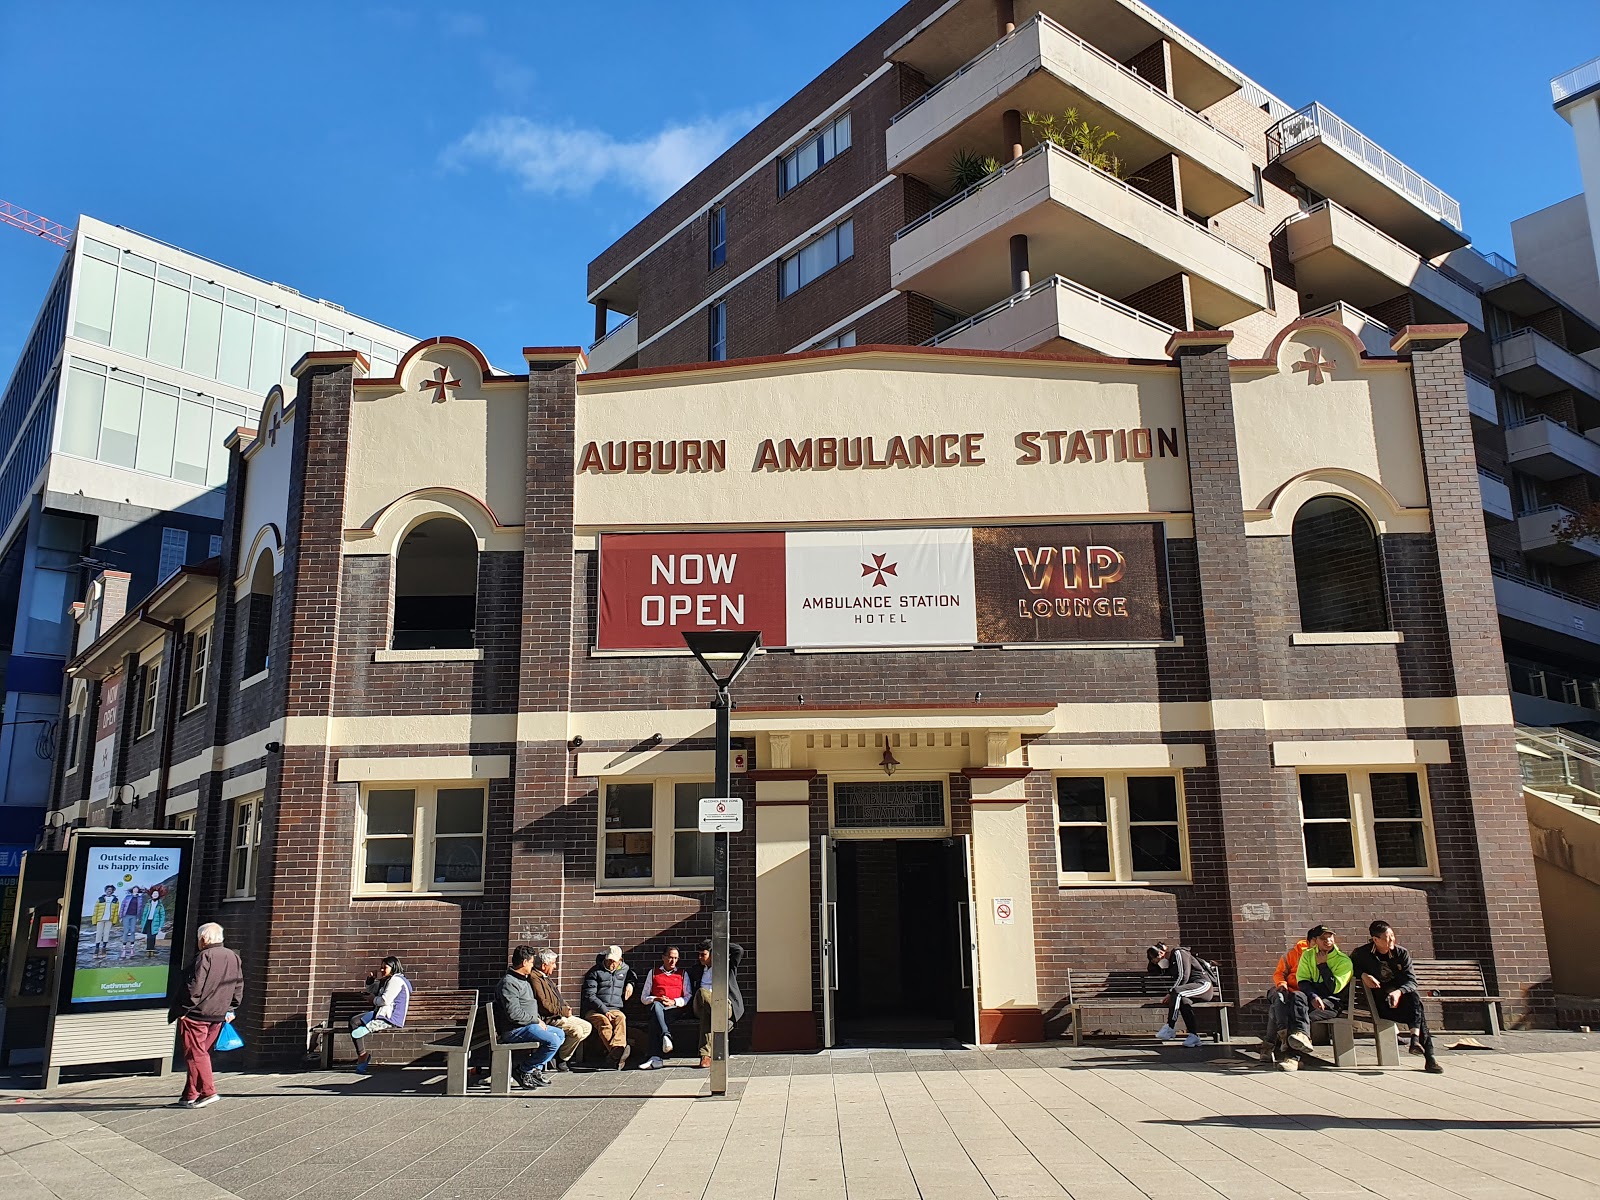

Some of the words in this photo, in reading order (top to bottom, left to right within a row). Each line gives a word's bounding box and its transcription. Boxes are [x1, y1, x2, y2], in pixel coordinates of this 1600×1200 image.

[577, 439, 726, 473] AUBURN
[752, 433, 986, 472] AMBULANCE
[1015, 428, 1179, 465] STATION
[651, 553, 738, 585] NOW
[1013, 545, 1126, 593] VIP
[802, 596, 892, 609] AMBULANCE
[899, 594, 960, 607] STATION
[1018, 597, 1128, 618] LOUNGE
[641, 594, 745, 626] OPEN
[854, 613, 907, 624] HOTEL
[849, 792, 924, 805] AMBULANCE
[863, 806, 915, 819] STATION
[100, 853, 137, 862] Outside
[138, 853, 169, 862] makes
[111, 862, 140, 872] happy
[141, 862, 169, 870] inside
[101, 981, 142, 989] Kathmandu
